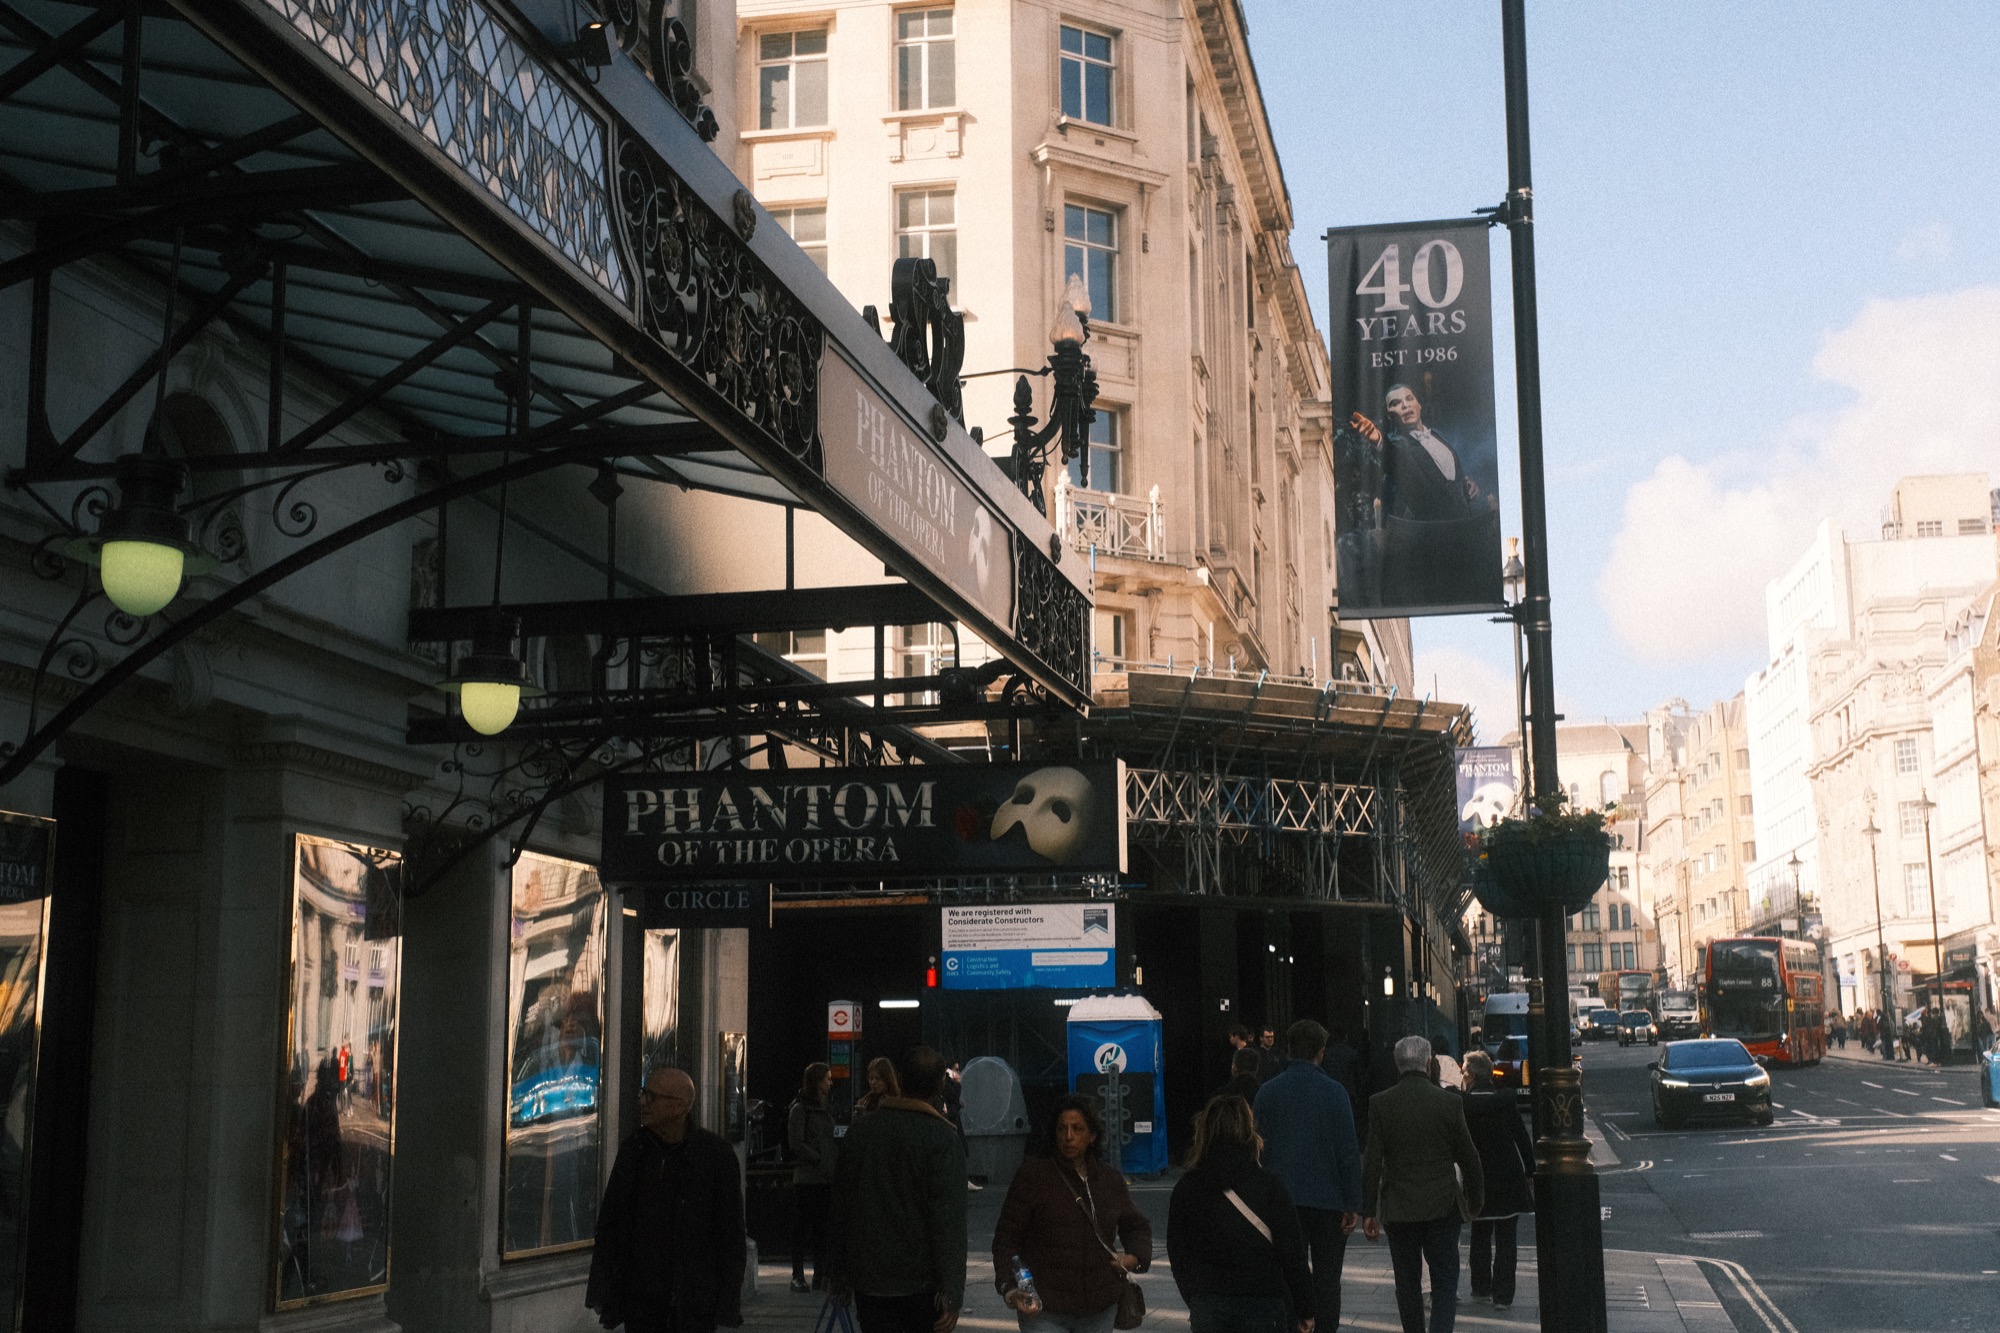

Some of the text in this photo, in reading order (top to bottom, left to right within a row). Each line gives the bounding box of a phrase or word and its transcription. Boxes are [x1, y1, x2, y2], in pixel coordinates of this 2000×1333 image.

[1356, 238, 1464, 313] 40
[1356, 310, 1467, 341] YEARS
[1371, 345, 1458, 368] EST 1986
[856, 389, 956, 537] PHANTOM
[868, 471, 945, 565] OF THE OPERA
[1459, 763, 1509, 774] PHANTOM
[623, 781, 937, 835] PHANTOM
[657, 836, 900, 866] OF THE OPERA
[664, 891, 750, 909] CIRCLE
[948, 909, 960, 917] We
[974, 908, 1013, 918] registered
[1015, 907, 1032, 915] with
[948, 916, 1044, 926] Considerate Constructors
[1488, 946, 1501, 955] 40
[1586, 973, 1600, 981] FIV
[1761, 978, 1772, 987] 88
